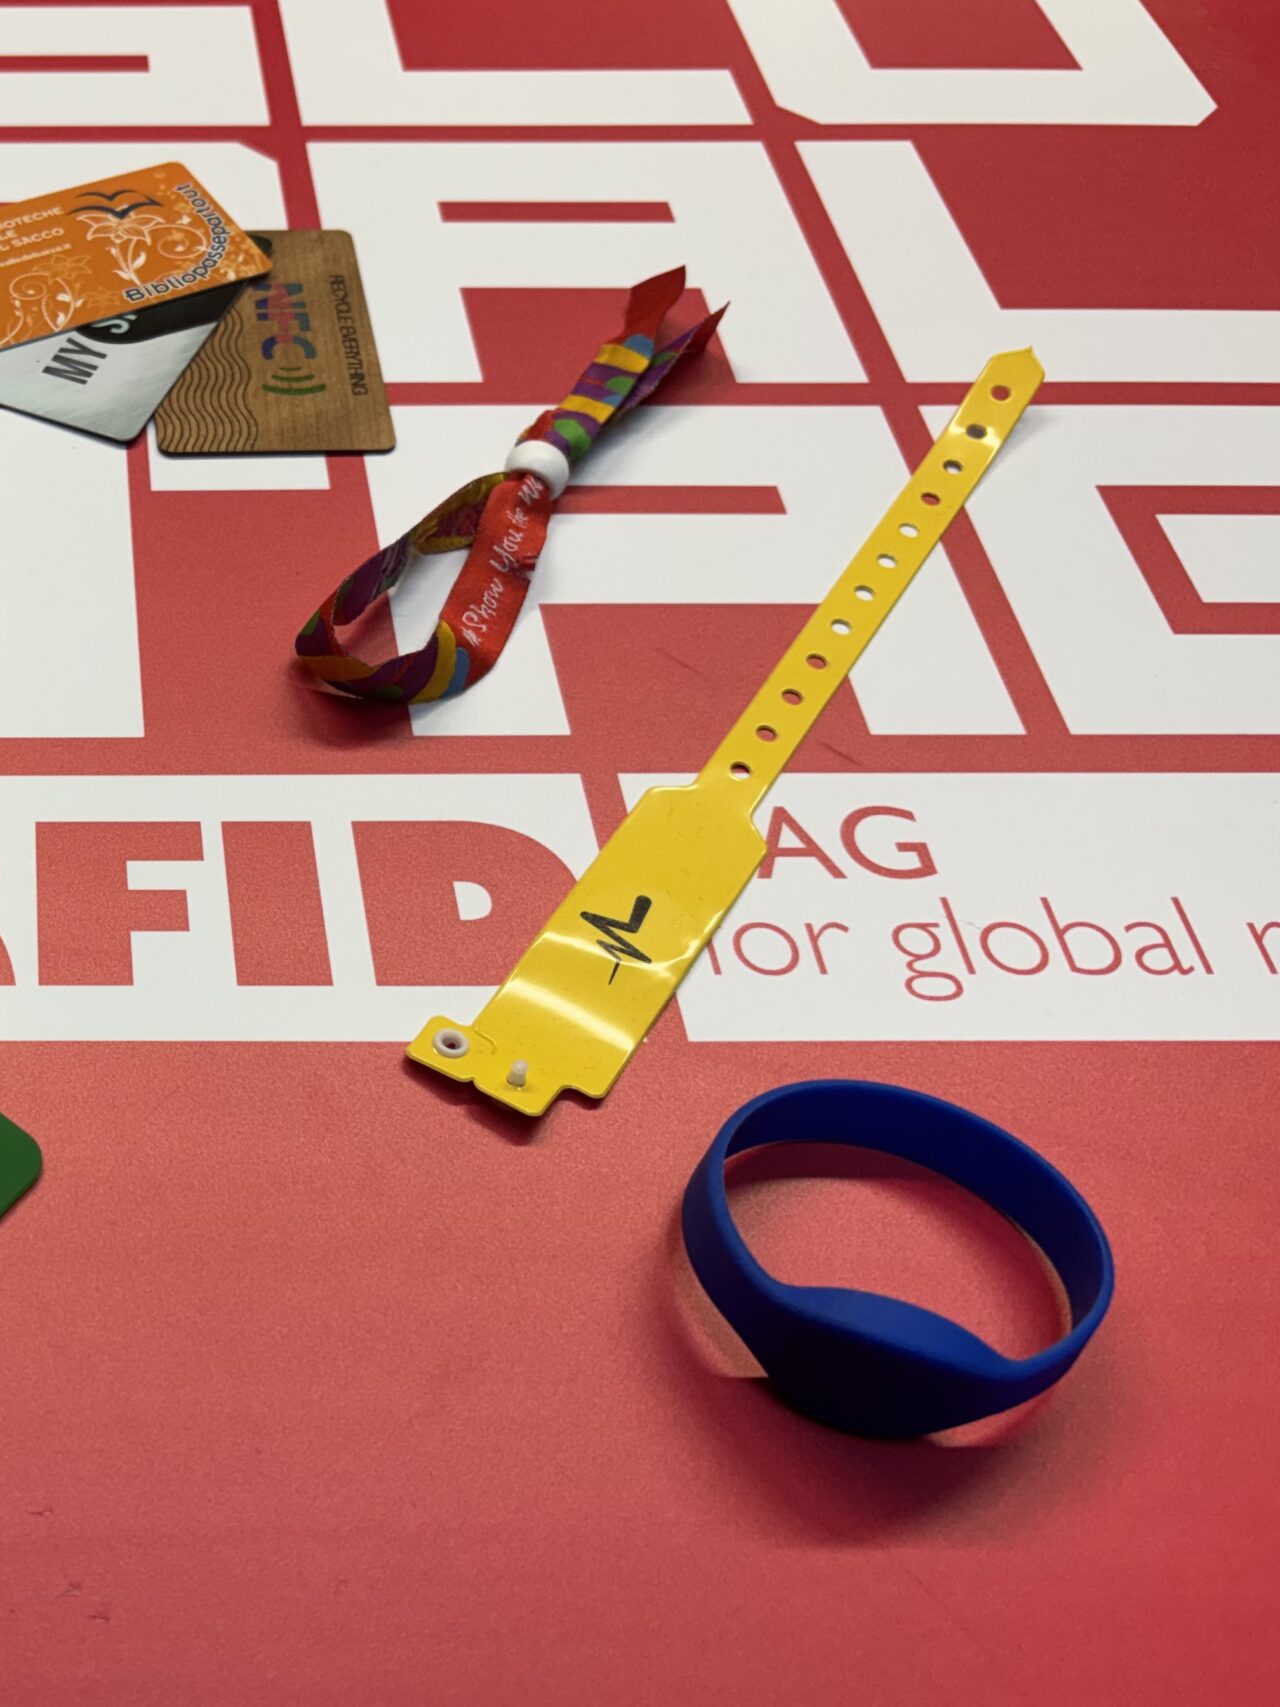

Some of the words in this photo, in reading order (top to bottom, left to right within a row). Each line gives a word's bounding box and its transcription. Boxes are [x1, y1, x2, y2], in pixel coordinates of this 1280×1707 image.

[12, 227, 65, 248] SACCO
[125, 184, 230, 302] Bibliopassepartout
[252, 283, 317, 360] NFC
[330, 274, 354, 327] RECYCLE
[42, 337, 108, 385] MY
[340, 325, 369, 397] EVERYTHING
[756, 805, 939, 881] AG
[891, 896, 1216, 1002] global
